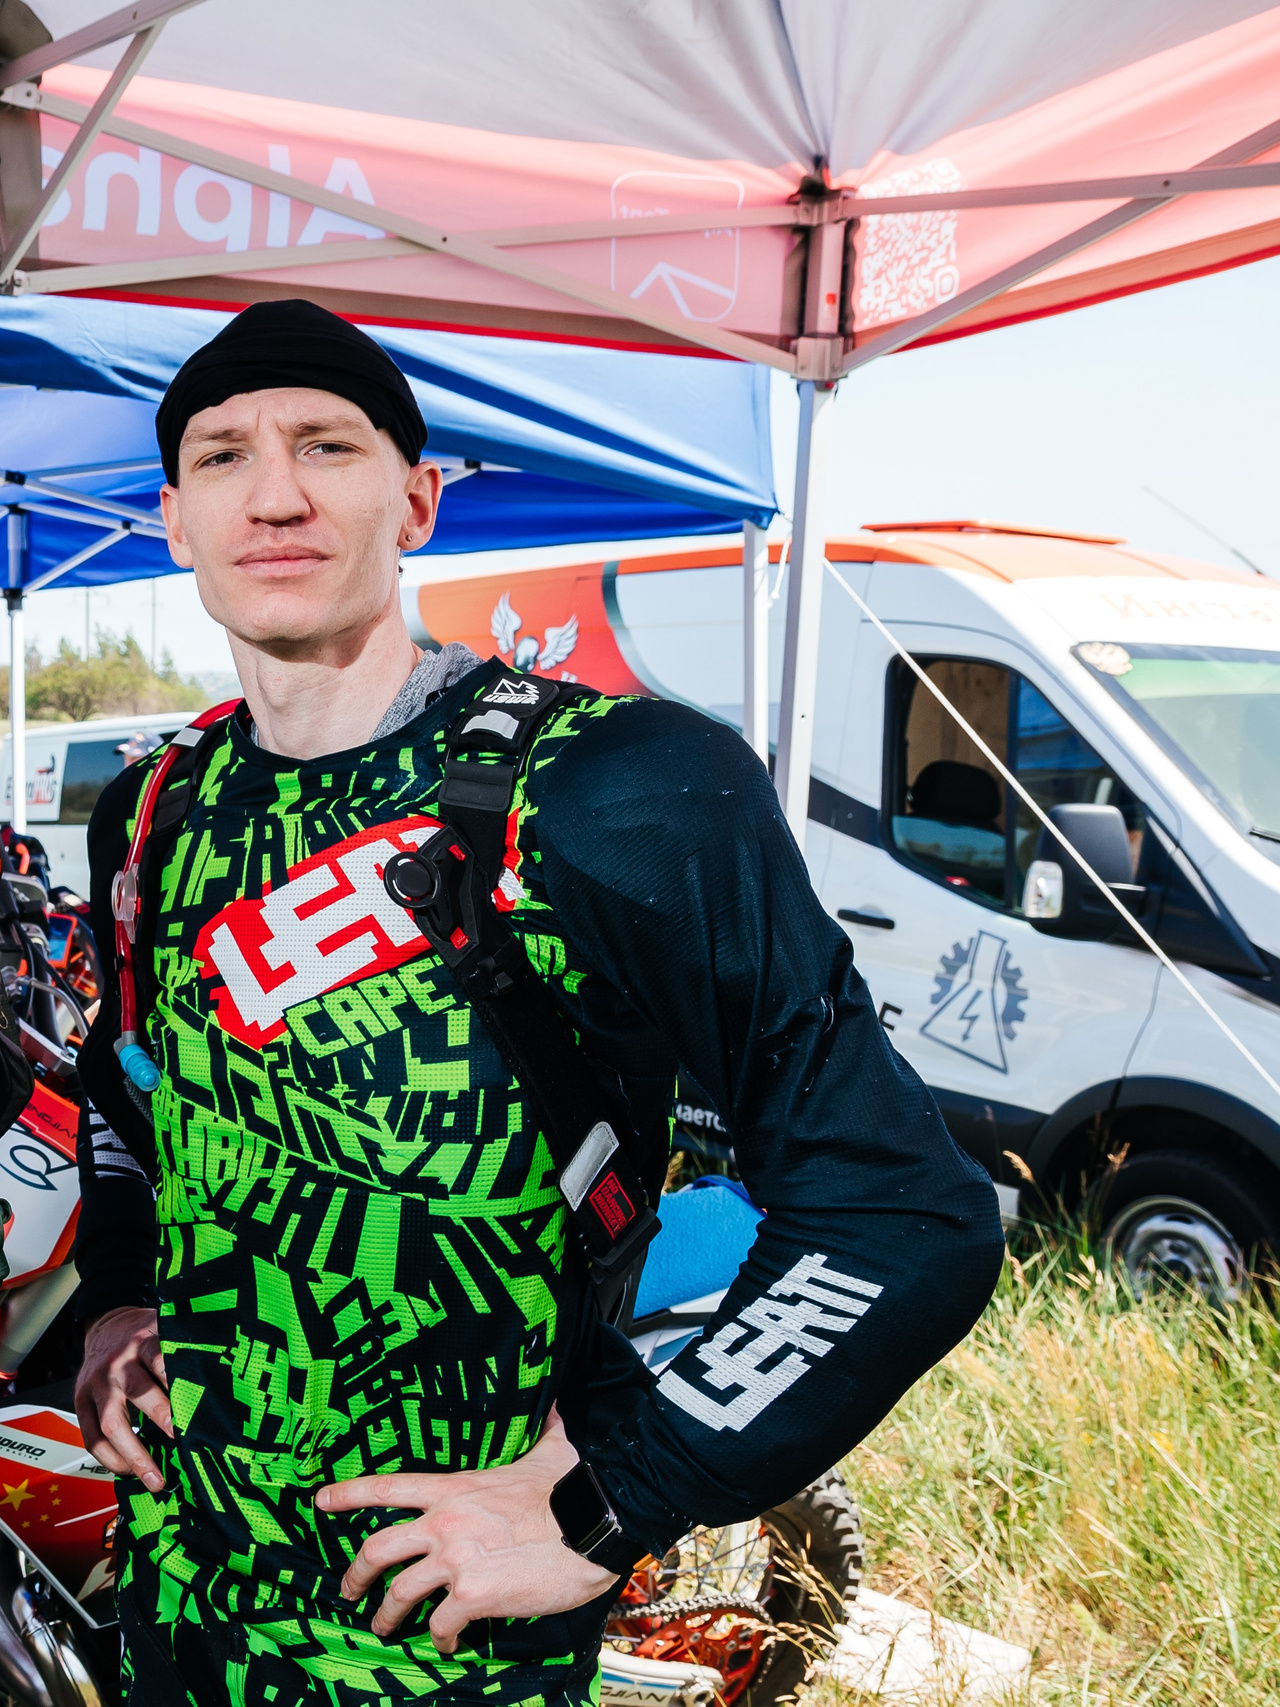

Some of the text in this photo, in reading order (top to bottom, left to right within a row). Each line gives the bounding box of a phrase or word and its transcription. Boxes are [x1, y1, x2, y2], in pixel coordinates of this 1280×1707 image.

[606, 1179, 619, 1195] NO
[594, 1193, 621, 1231] MONKEY
[656, 1253, 884, 1432] LEATT
